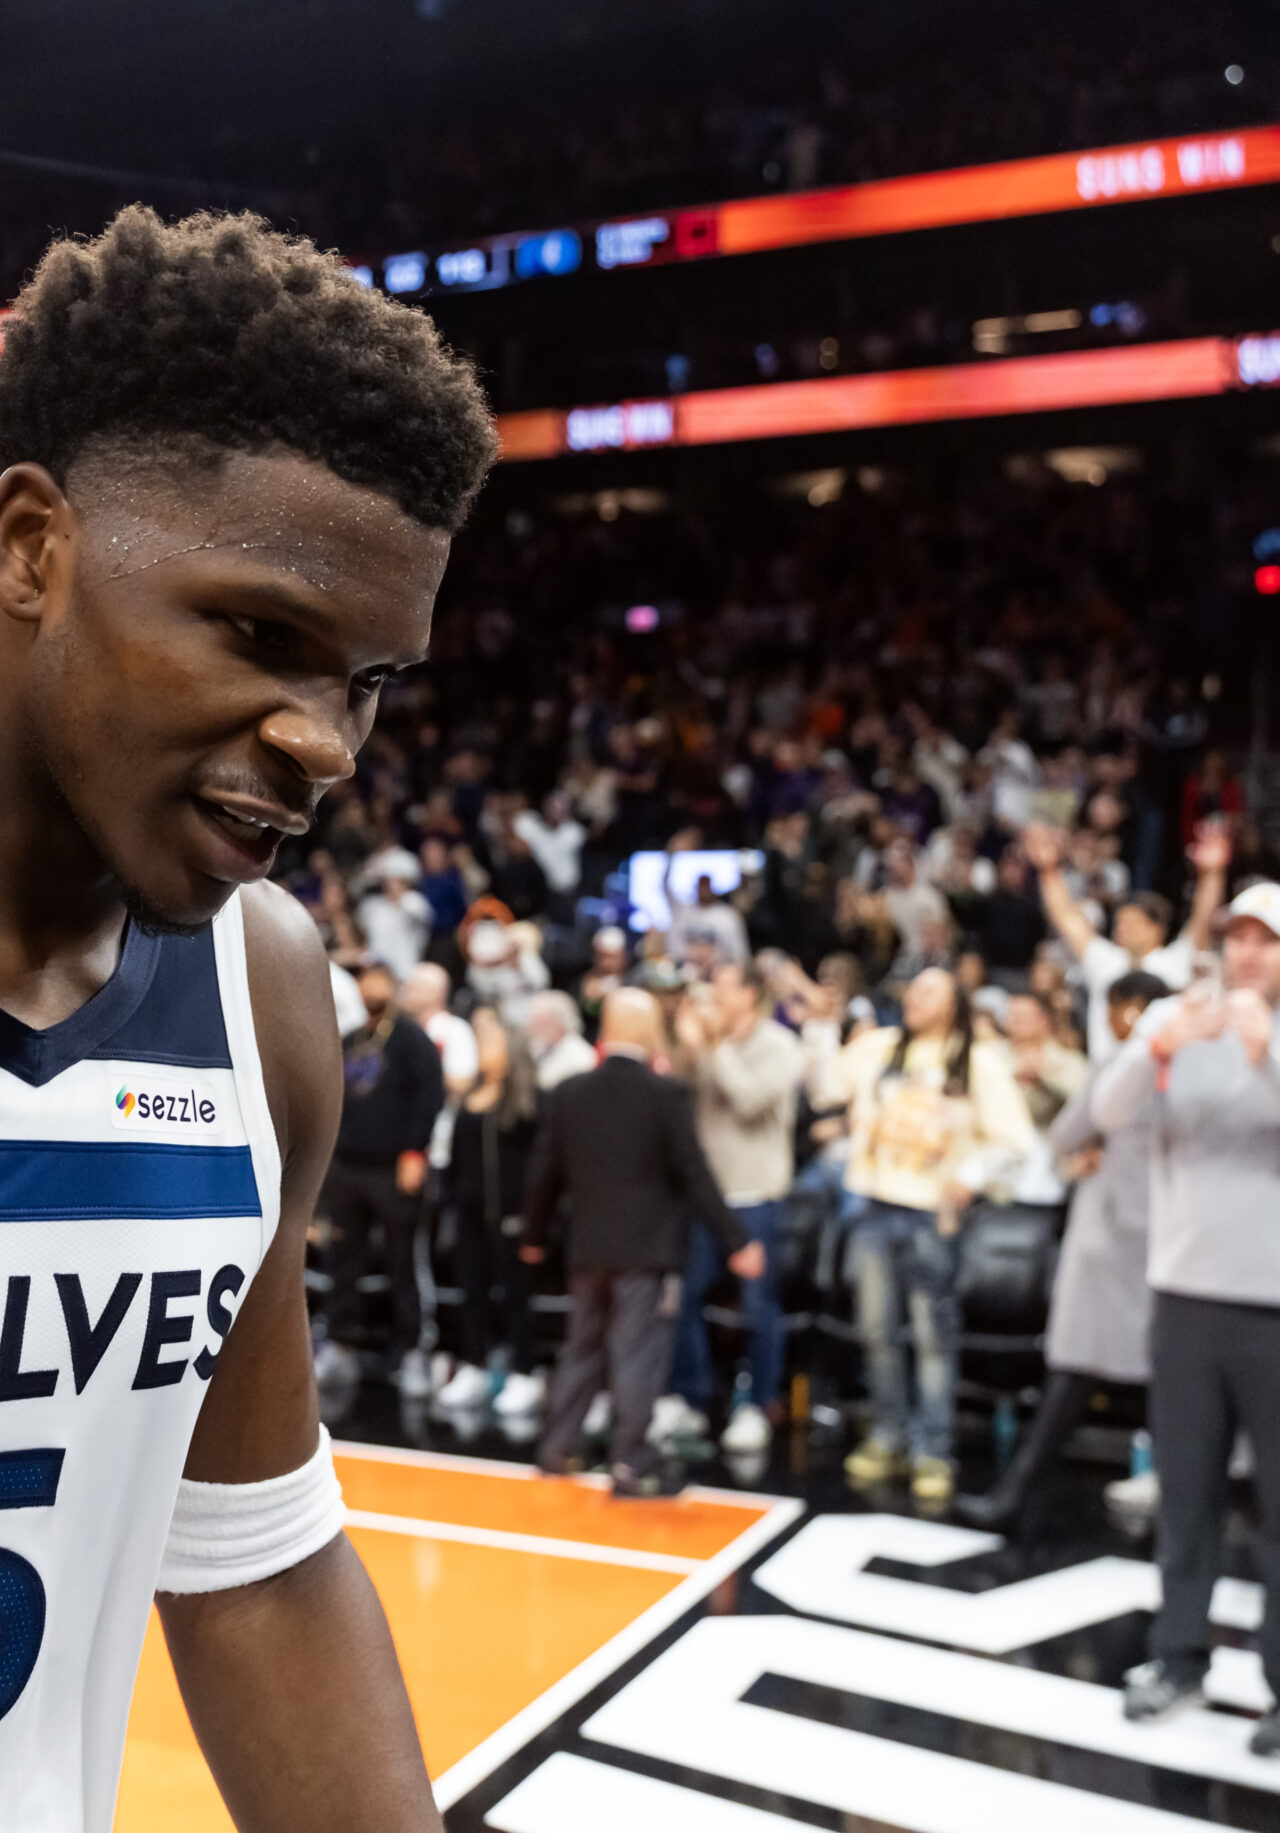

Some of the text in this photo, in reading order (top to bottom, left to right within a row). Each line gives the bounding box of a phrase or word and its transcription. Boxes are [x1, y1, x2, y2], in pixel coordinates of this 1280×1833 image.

[1076, 136, 1246, 200] SUNS WIN
[137, 1089, 216, 1124] sezzle
